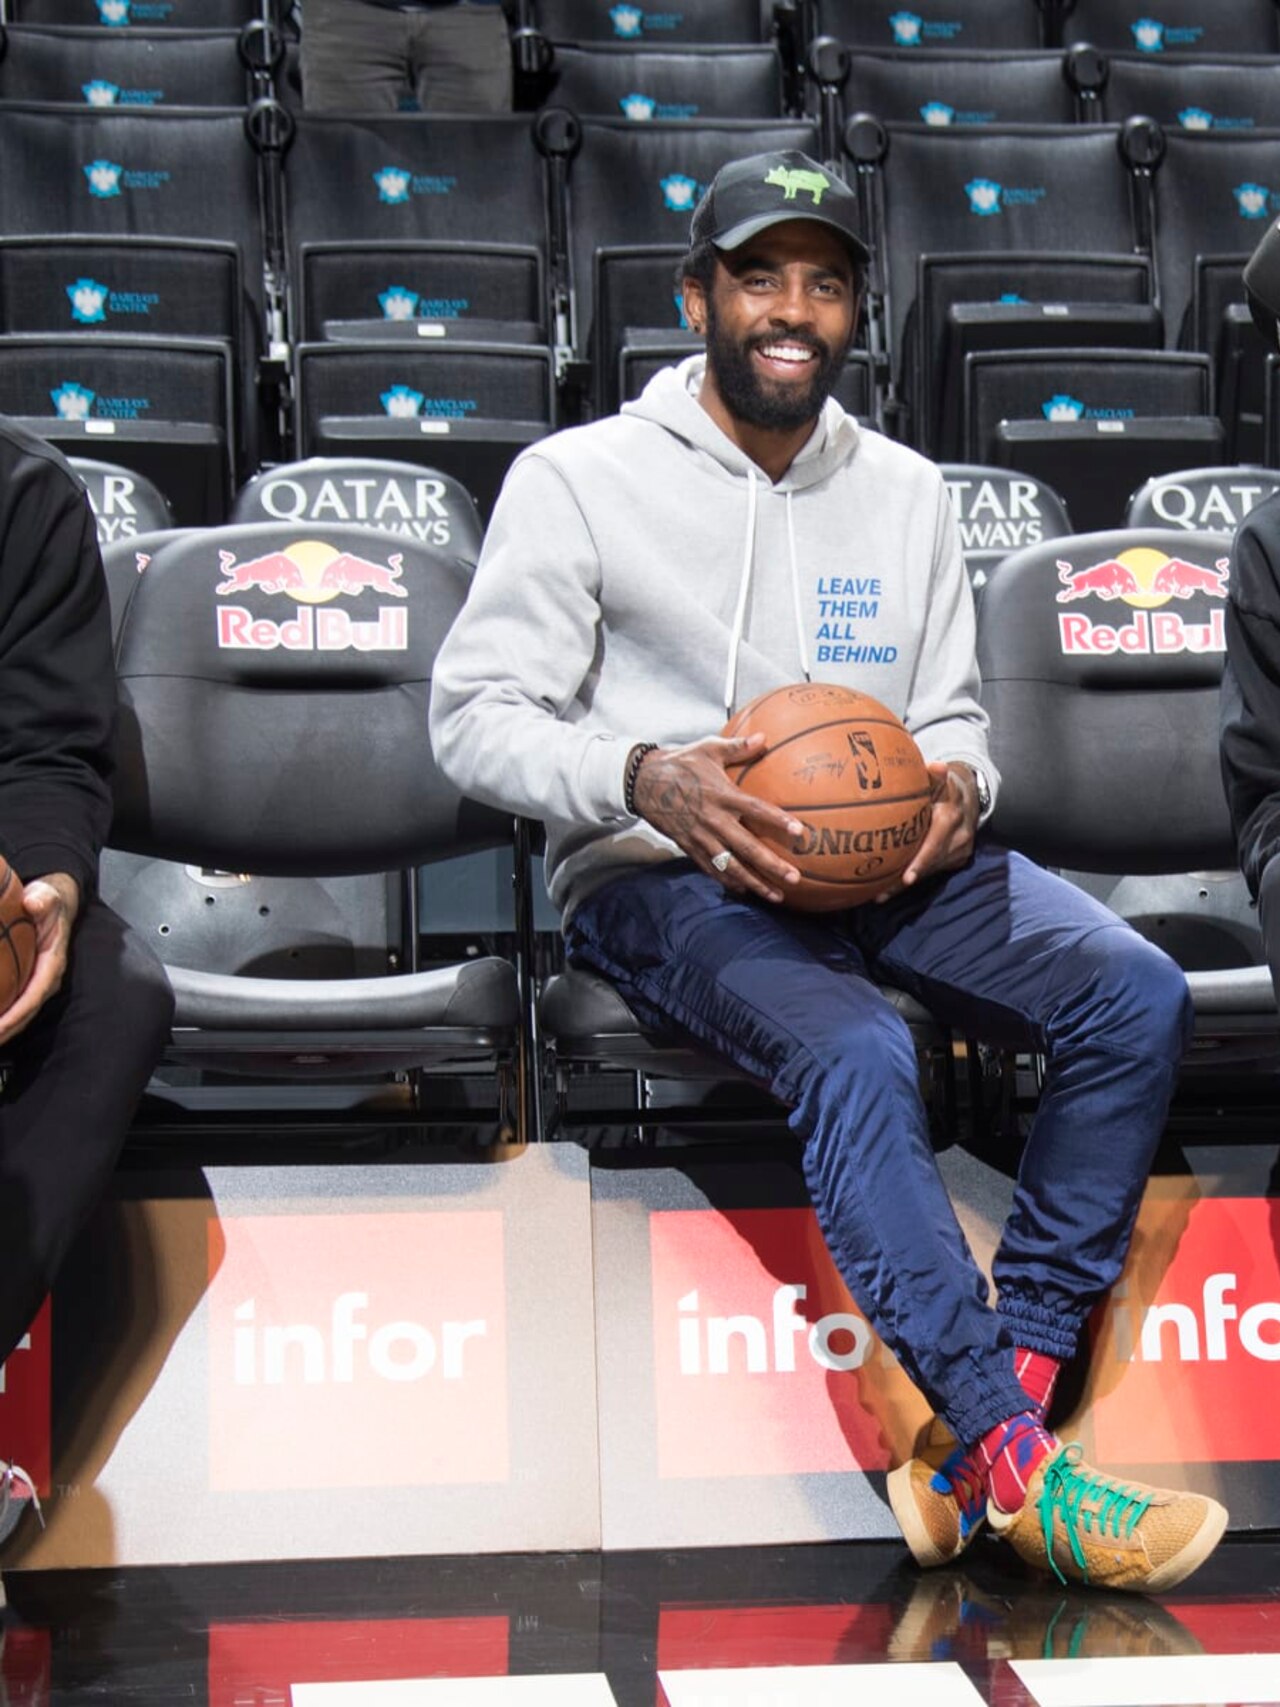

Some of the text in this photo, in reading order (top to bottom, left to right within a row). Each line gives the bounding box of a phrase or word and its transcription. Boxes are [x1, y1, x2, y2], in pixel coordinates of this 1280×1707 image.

[260, 478, 450, 521] QATAR
[945, 480, 1041, 519] TAR
[1152, 484, 1279, 530] QAT
[958, 520, 1043, 548] WAYS
[817, 577, 881, 595] LEAVE
[216, 606, 408, 651] Red Bull
[818, 600, 878, 618] THEM
[815, 623, 856, 640] ALL
[1058, 608, 1227, 654] Red Bul
[817, 645, 898, 663] BEHIND
[232, 1290, 486, 1386] infor
